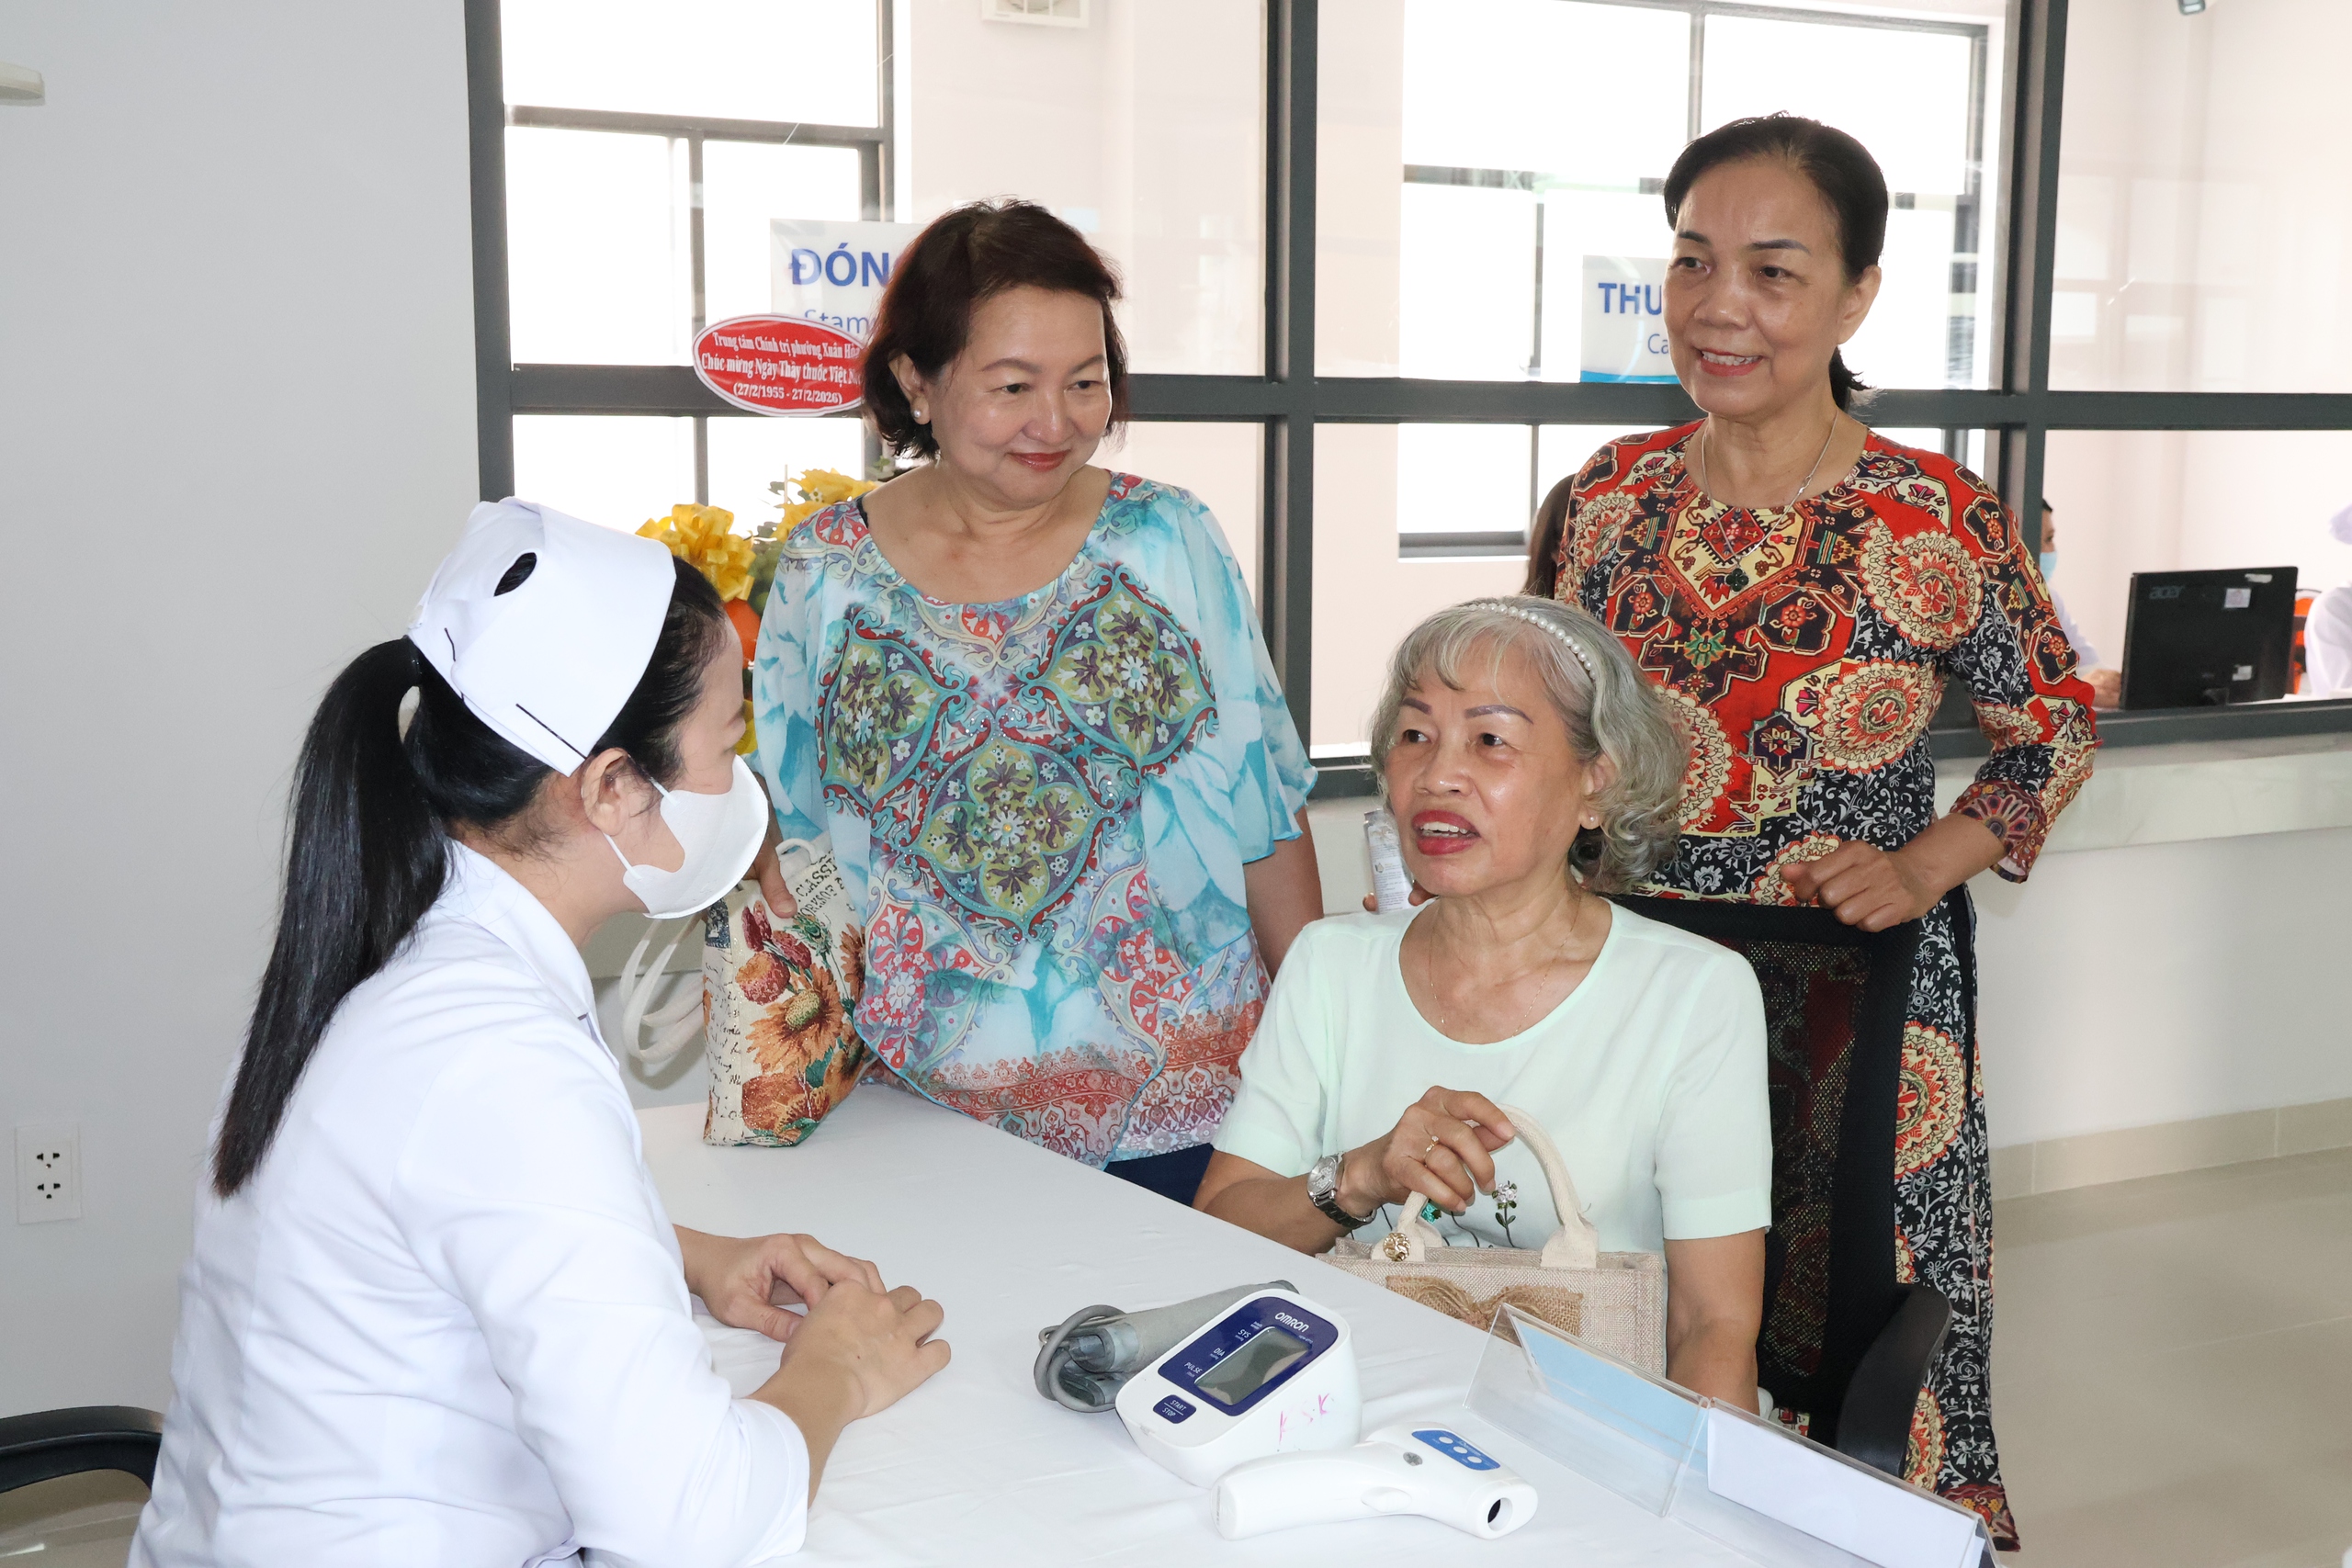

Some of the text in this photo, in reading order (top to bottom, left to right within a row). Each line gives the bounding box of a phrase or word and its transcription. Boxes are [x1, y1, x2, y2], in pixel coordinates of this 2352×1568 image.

[788, 243, 889, 288] ĐÓN
[1598, 283, 1662, 315] THU
[713, 332, 739, 352] Trung
[738, 334, 754, 350] tâm
[755, 336, 779, 353] Chính
[779, 339, 791, 356] trị
[791, 339, 822, 360] phường
[822, 343, 842, 358] Xuân
[1647, 333, 1668, 354] Ca
[701, 353, 724, 371] Chúc
[727, 355, 753, 378] mừng
[755, 358, 777, 381] Ngày
[779, 360, 801, 383] Thầy
[803, 363, 827, 381] thuốc
[830, 366, 847, 388] Việt
[733, 382, 785, 399] (27/2/1955
[792, 388, 842, 404] 27/2/2026)
[1275, 1312, 1309, 1332] OMRON
[1238, 1329, 1251, 1338] SYS
[1213, 1348, 1226, 1357] DIA
[1184, 1361, 1203, 1373] PULSE
[1162, 1407, 1176, 1417] STOP
[1170, 1400, 1187, 1411] START
